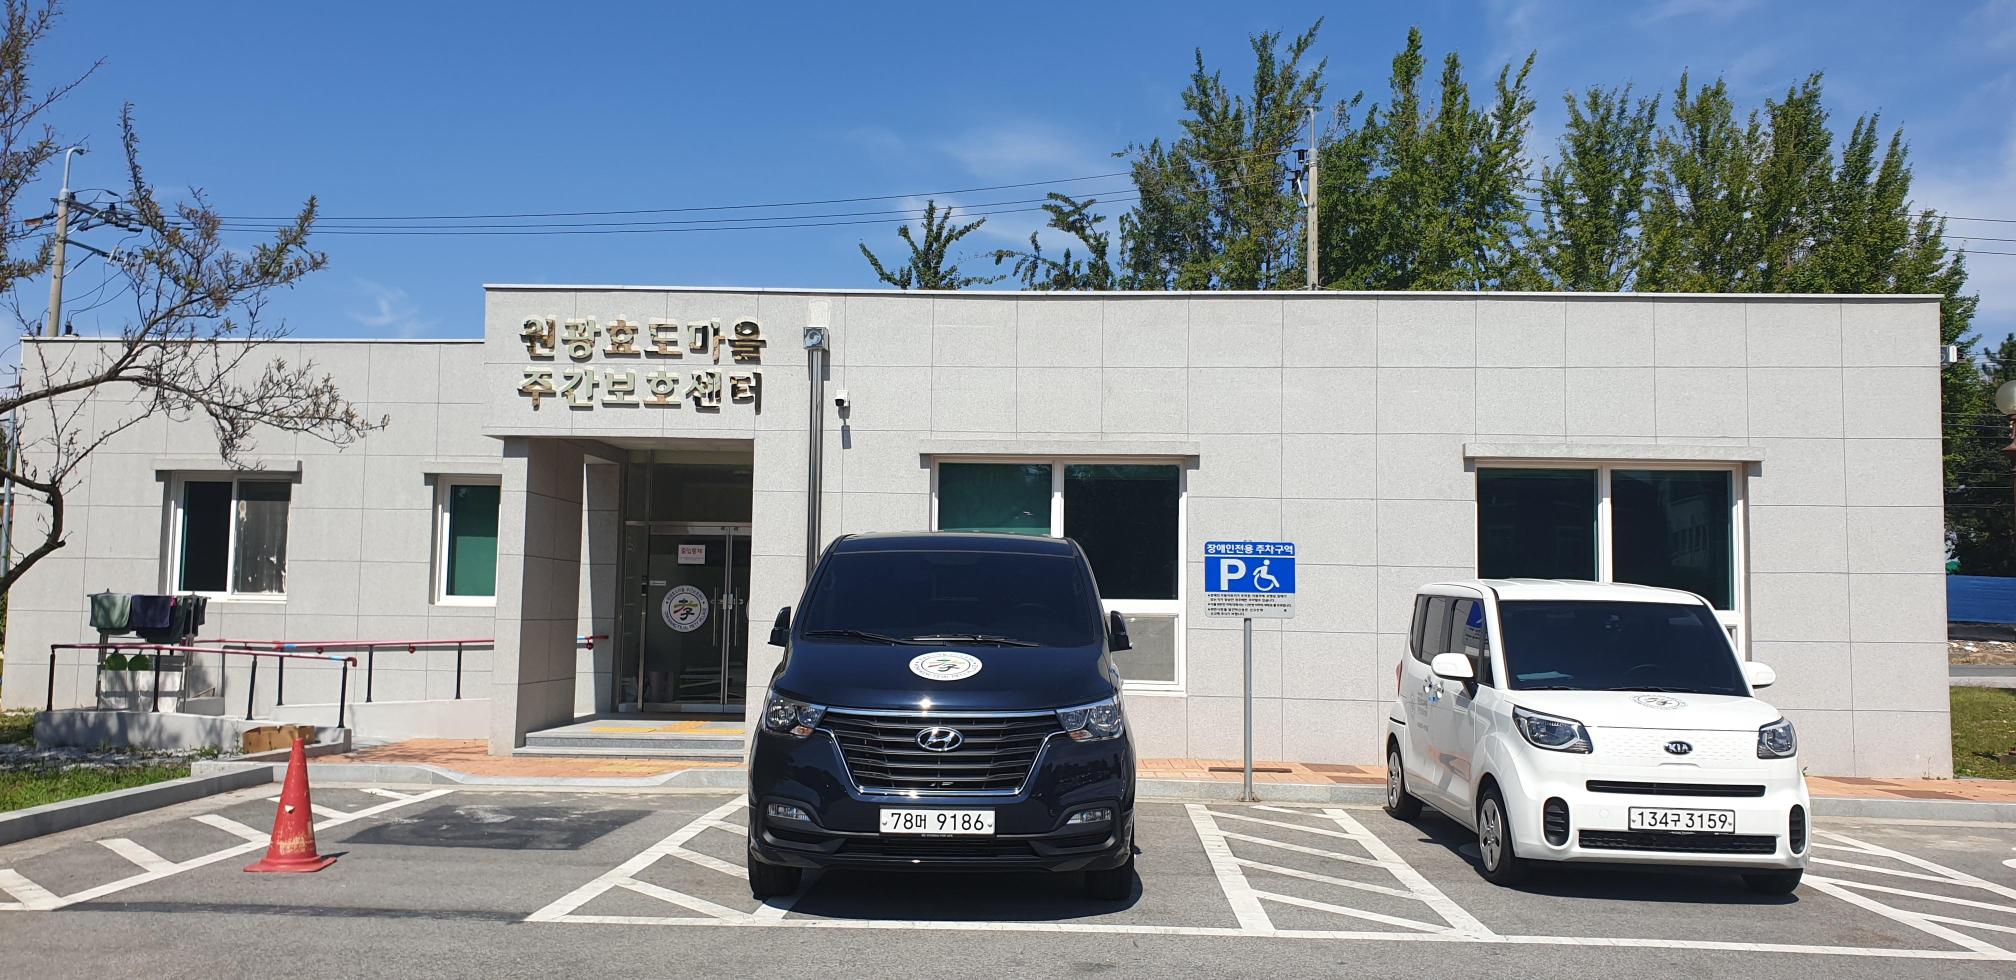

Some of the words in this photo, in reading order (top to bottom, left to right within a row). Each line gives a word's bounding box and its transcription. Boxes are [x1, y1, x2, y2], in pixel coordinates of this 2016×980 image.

[519, 315, 768, 364] 원광효도마을
[518, 366, 763, 415] 주간보호센터
[1206, 543, 1254, 554] 장애인전용
[1255, 544, 1293, 555] 주차구역
[1220, 558, 1247, 591] P
[1668, 743, 1690, 753] KIA
[891, 812, 927, 830] 78머
[936, 813, 984, 831] 9186
[1637, 811, 1681, 828] 134구
[1685, 812, 1728, 830] 3159
